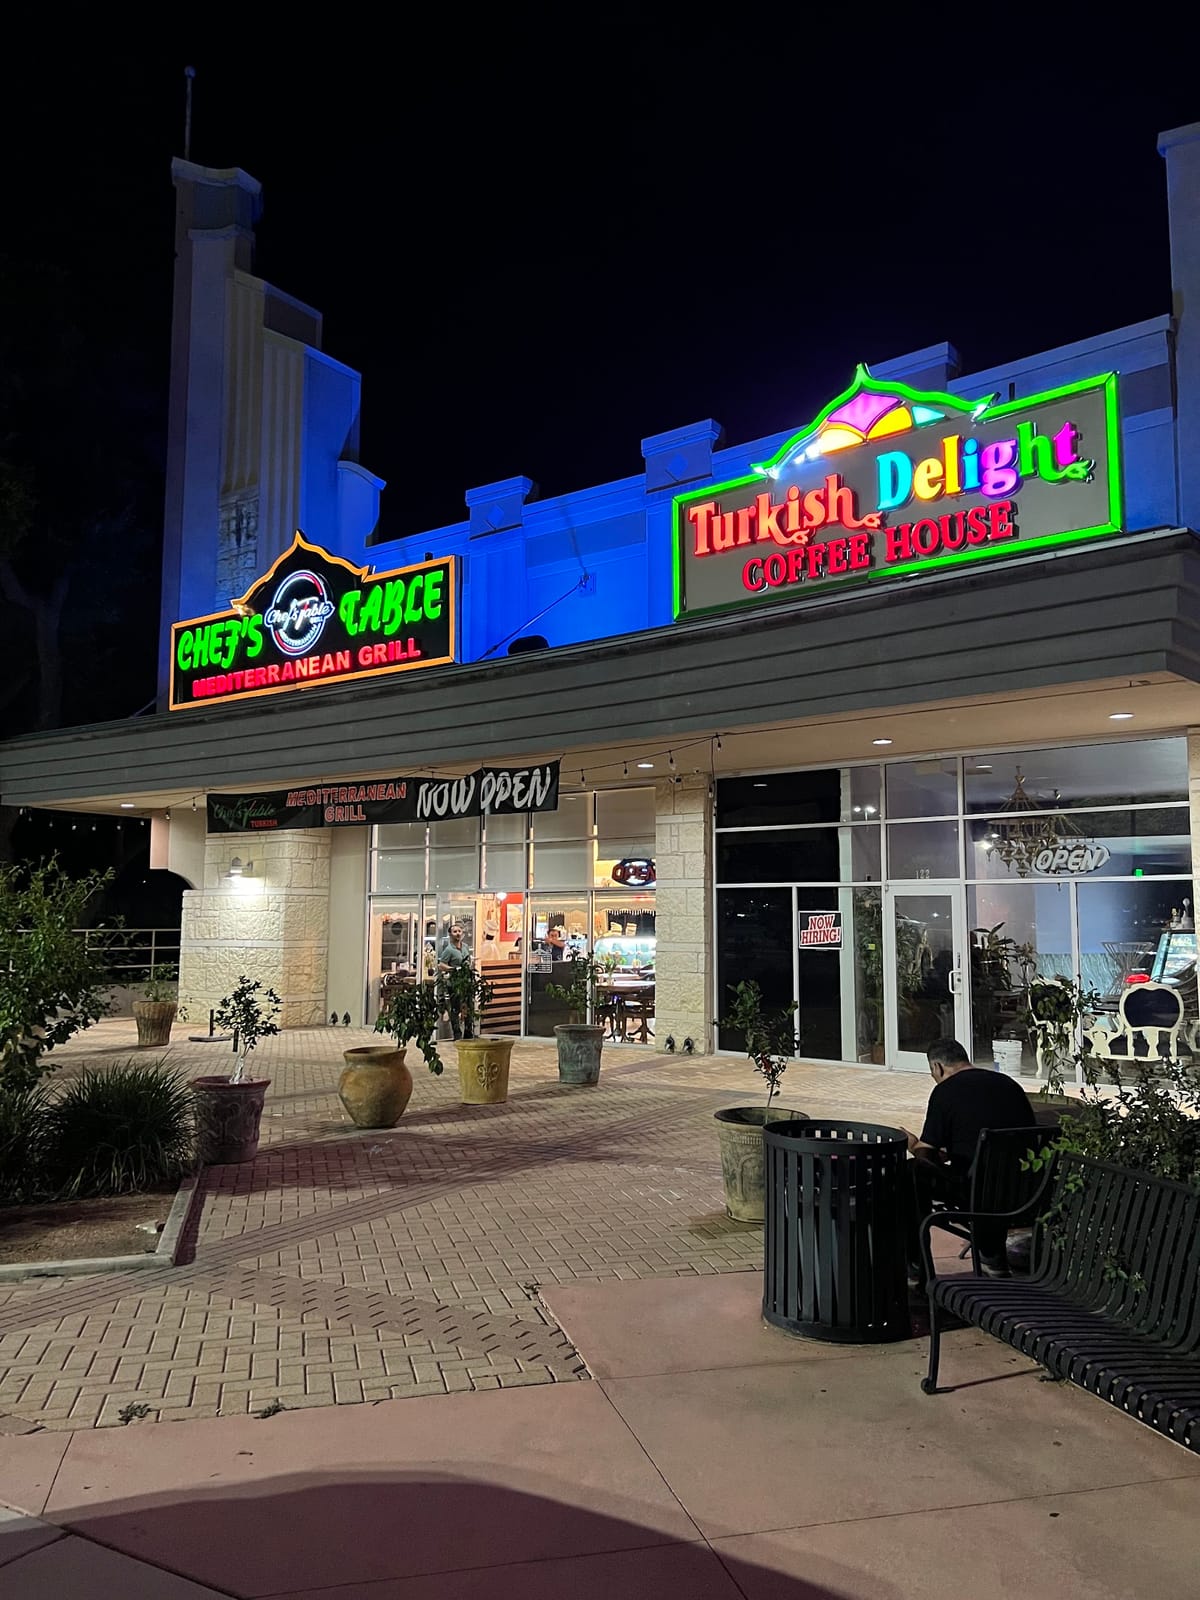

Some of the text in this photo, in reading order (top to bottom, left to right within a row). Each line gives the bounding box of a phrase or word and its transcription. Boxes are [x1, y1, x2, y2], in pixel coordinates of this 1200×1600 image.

[689, 421, 1094, 556] Turkish Delight
[742, 501, 1014, 591] COFFEE HOUSE
[177, 570, 444, 670] CHEF'S TABLE
[192, 638, 421, 697] MEDITERRANEAN GRILL
[286, 782, 406, 807] MEDITERRANEAN
[416, 766, 551, 818] NOW OPEN
[324, 805, 367, 823] GRILL
[1036, 847, 1104, 871] OPEN
[800, 928, 841, 945] HIRING!
[809, 914, 835, 930] NOW
